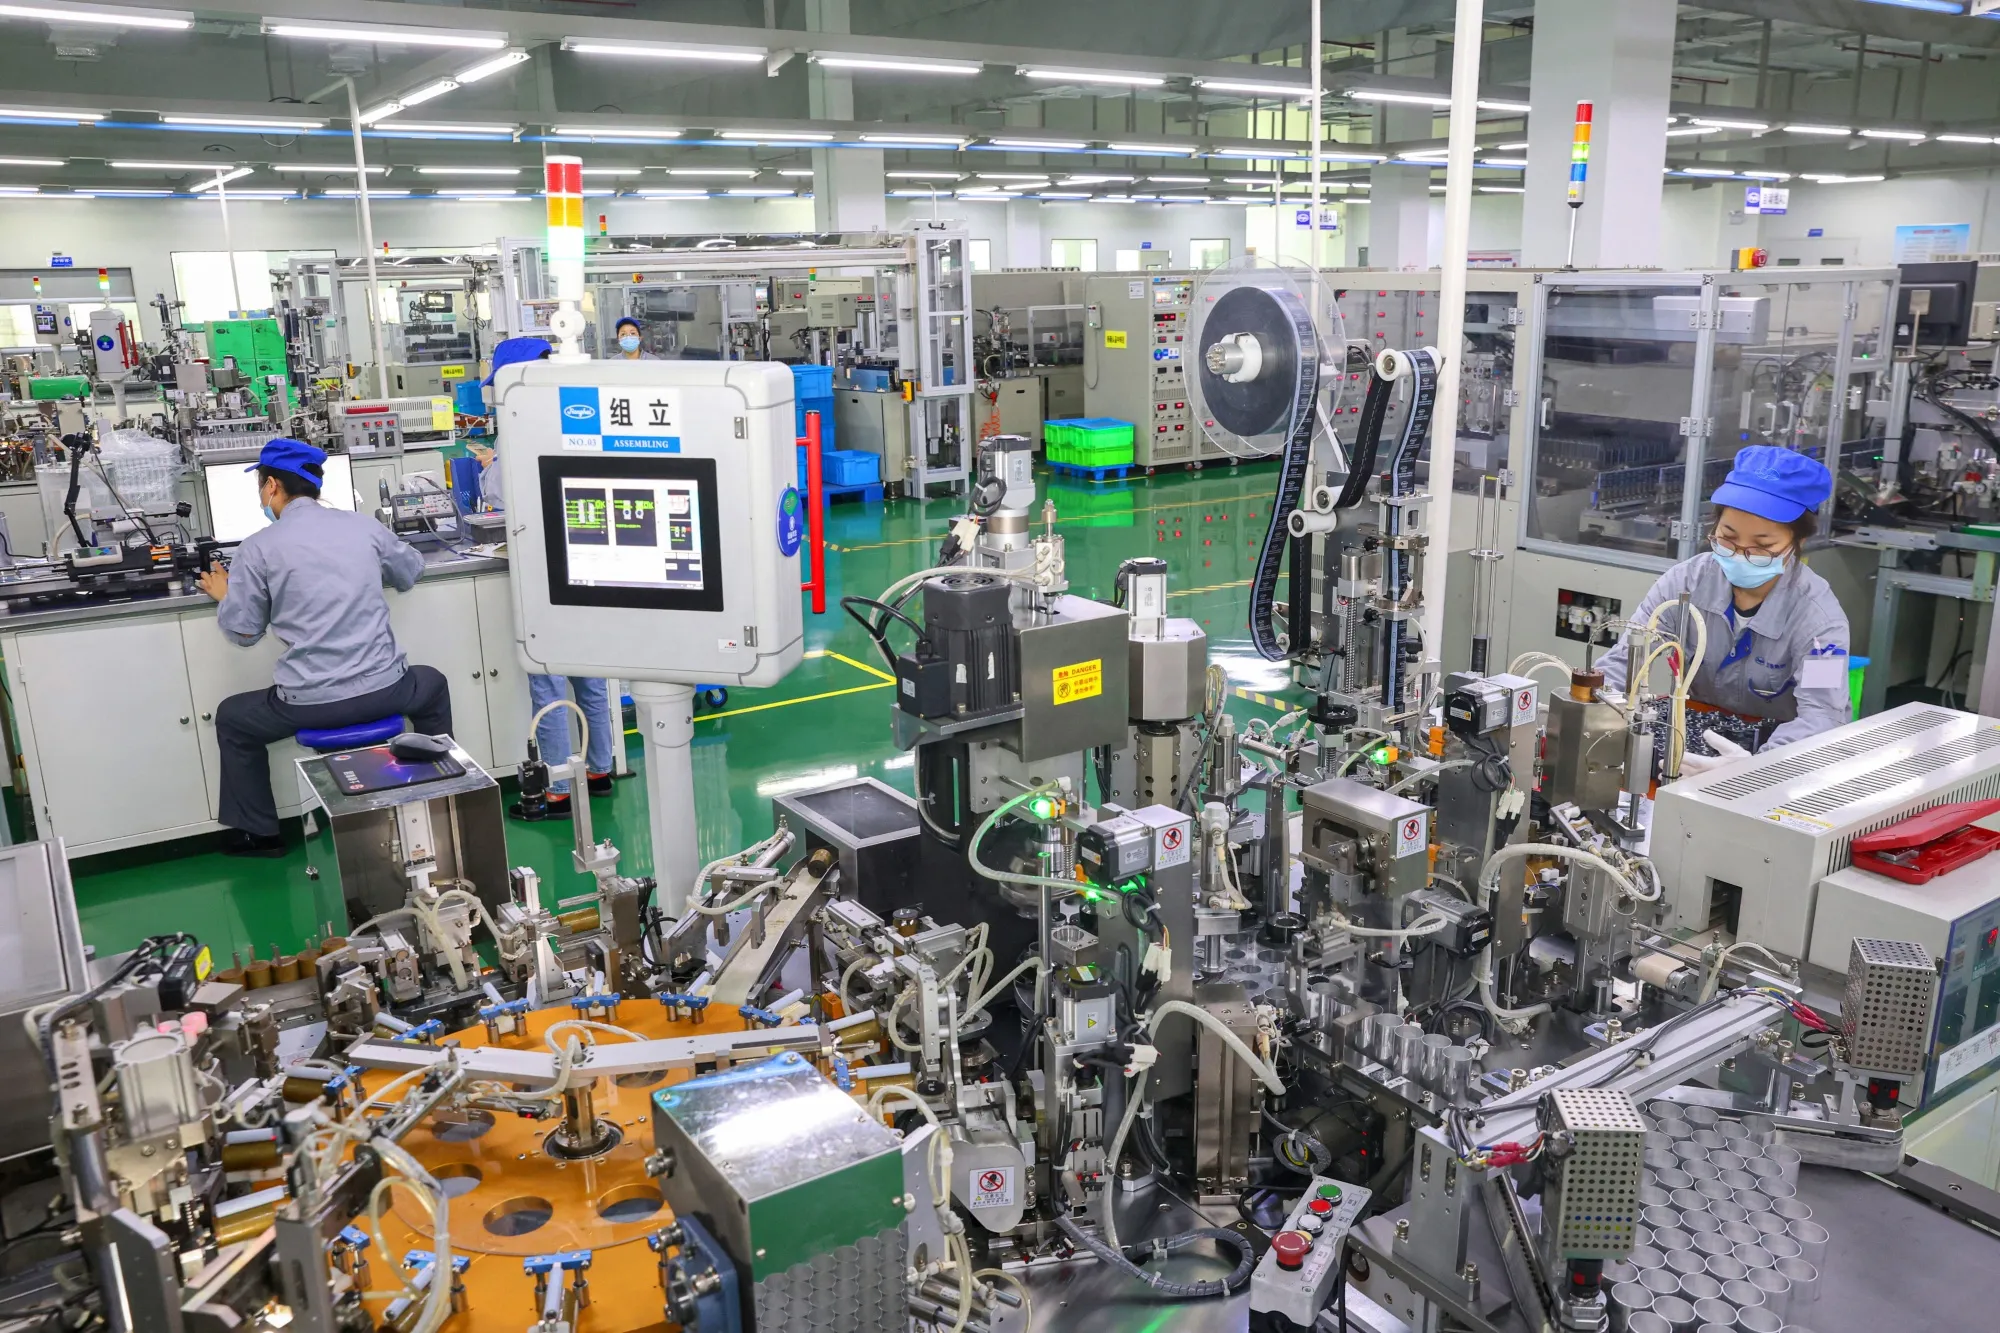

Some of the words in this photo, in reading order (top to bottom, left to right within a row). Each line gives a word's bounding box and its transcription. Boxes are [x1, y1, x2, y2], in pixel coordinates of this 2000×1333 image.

[610, 398, 671, 426] 组立
[613, 439, 669, 449] ASSEMBLING
[1071, 664, 1097, 675] DANGER
